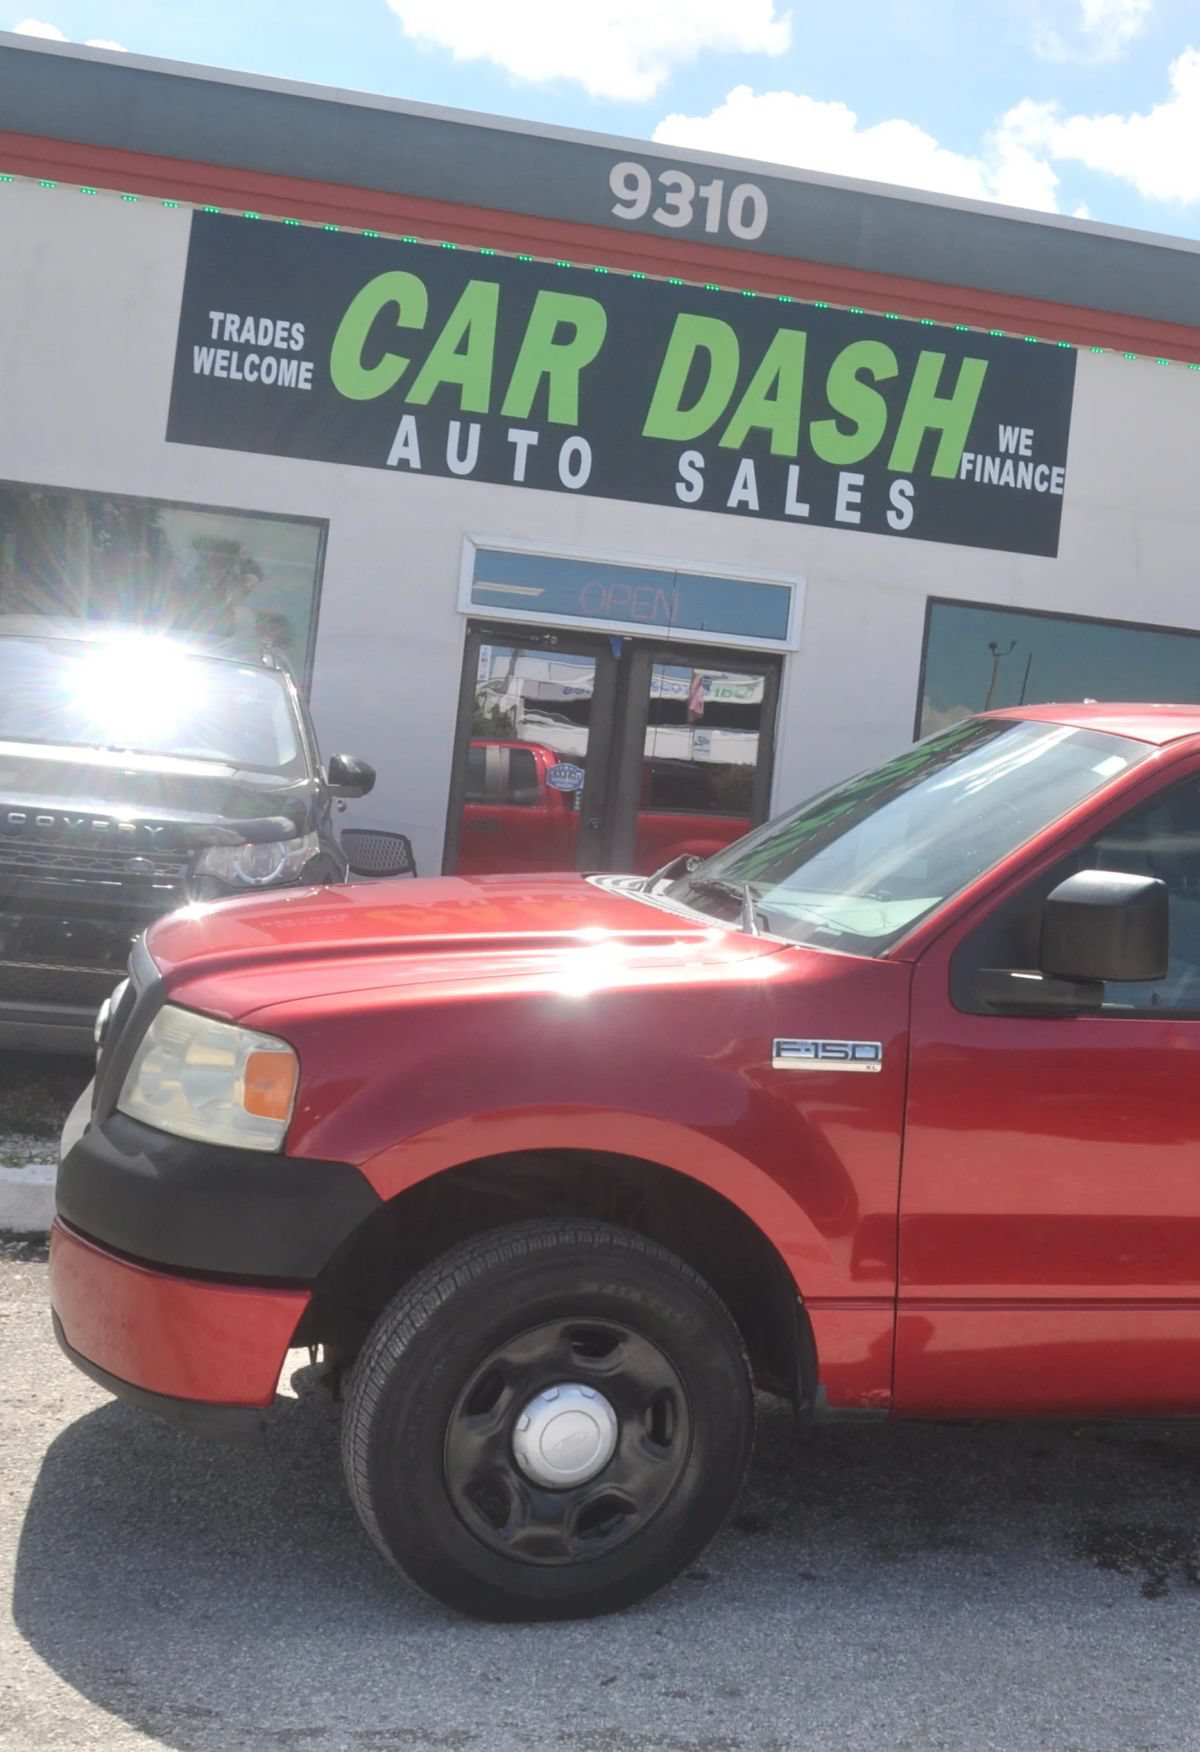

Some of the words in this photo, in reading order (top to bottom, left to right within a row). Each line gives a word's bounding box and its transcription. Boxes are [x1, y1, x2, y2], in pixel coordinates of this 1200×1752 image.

[608, 161, 769, 241] 9310
[208, 310, 306, 352] TRADES
[192, 345, 315, 391] WELCOME
[329, 270, 608, 427] CAR
[641, 312, 990, 480] DASH
[998, 423, 1035, 457] WE
[385, 414, 593, 490] AUTO
[674, 449, 916, 531] SALES
[959, 452, 1066, 496] FINANCE
[579, 580, 681, 624] OPEN
[8, 812, 164, 836] COVERY
[774, 1040, 880, 1062] F-150
